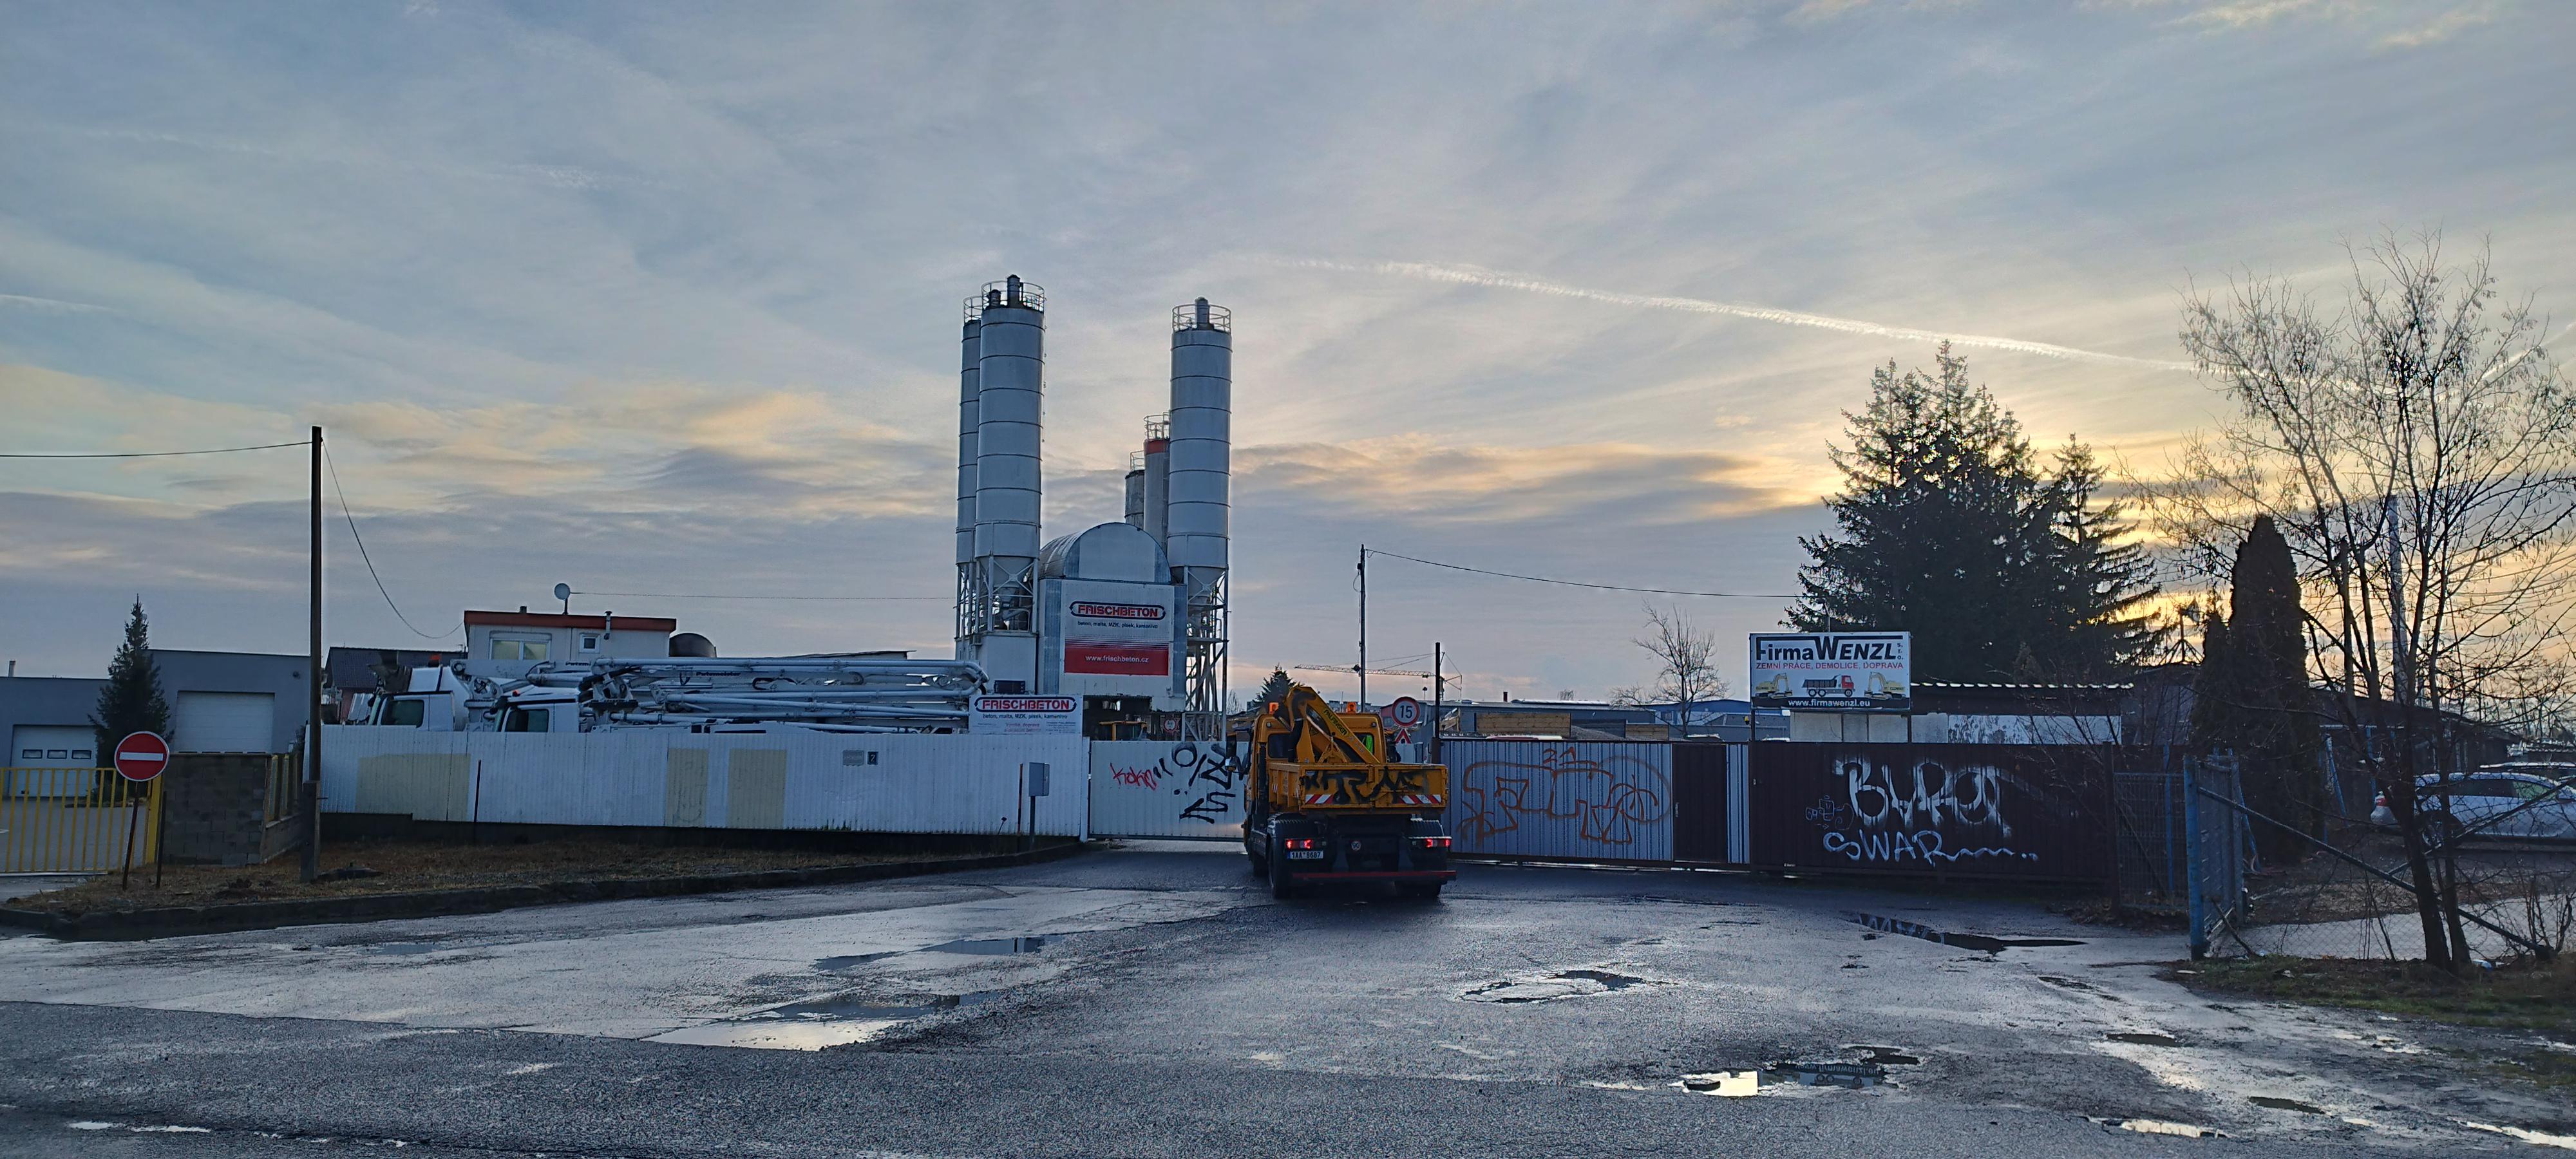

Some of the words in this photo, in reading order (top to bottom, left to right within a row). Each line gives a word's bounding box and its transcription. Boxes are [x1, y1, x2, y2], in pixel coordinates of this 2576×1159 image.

[1078, 605, 1158, 617] FRISCHBETON
[1085, 654, 1149, 663] www.frischbeton.cz
[1756, 661, 1781, 670] ZEMNÍ
[1783, 661, 1814, 670] PRÁCE,
[1815, 662, 1860, 670] DEMOLICE,
[1863, 661, 1904, 670] DOPRAVA
[982, 700, 1070, 710] FRISCHBETON
[1788, 699, 1871, 708] www.firmawenzl.eu
[1400, 705, 1413, 719] 15
[870, 754, 875, 762] 2
